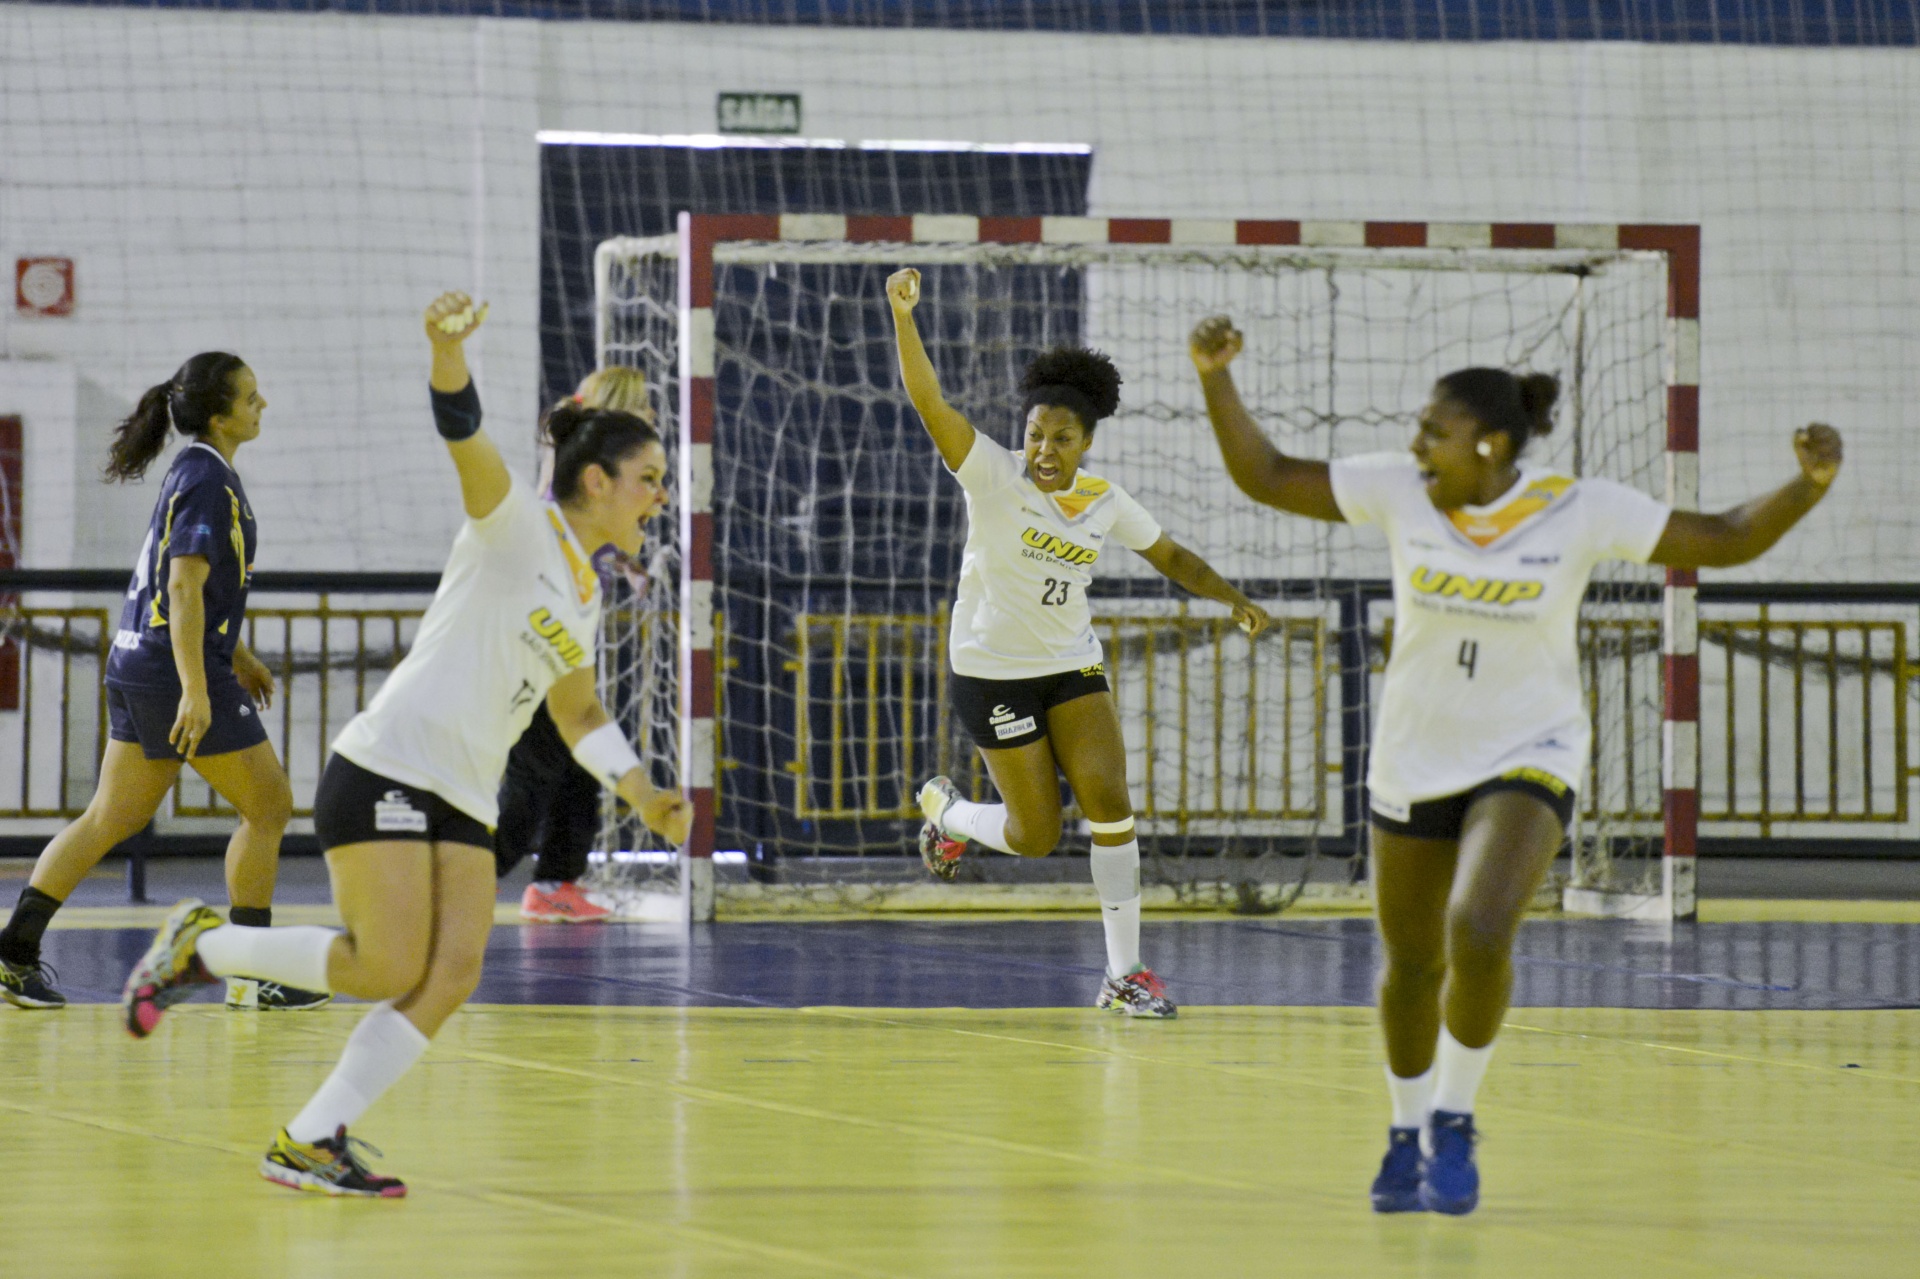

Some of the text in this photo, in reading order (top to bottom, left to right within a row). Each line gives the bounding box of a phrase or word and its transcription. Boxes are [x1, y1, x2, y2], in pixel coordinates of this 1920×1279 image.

[1021, 526, 1099, 566] UNIP
[1041, 577, 1072, 607] 23
[1410, 565, 1543, 606] UNIP
[1458, 639, 1478, 680] 4
